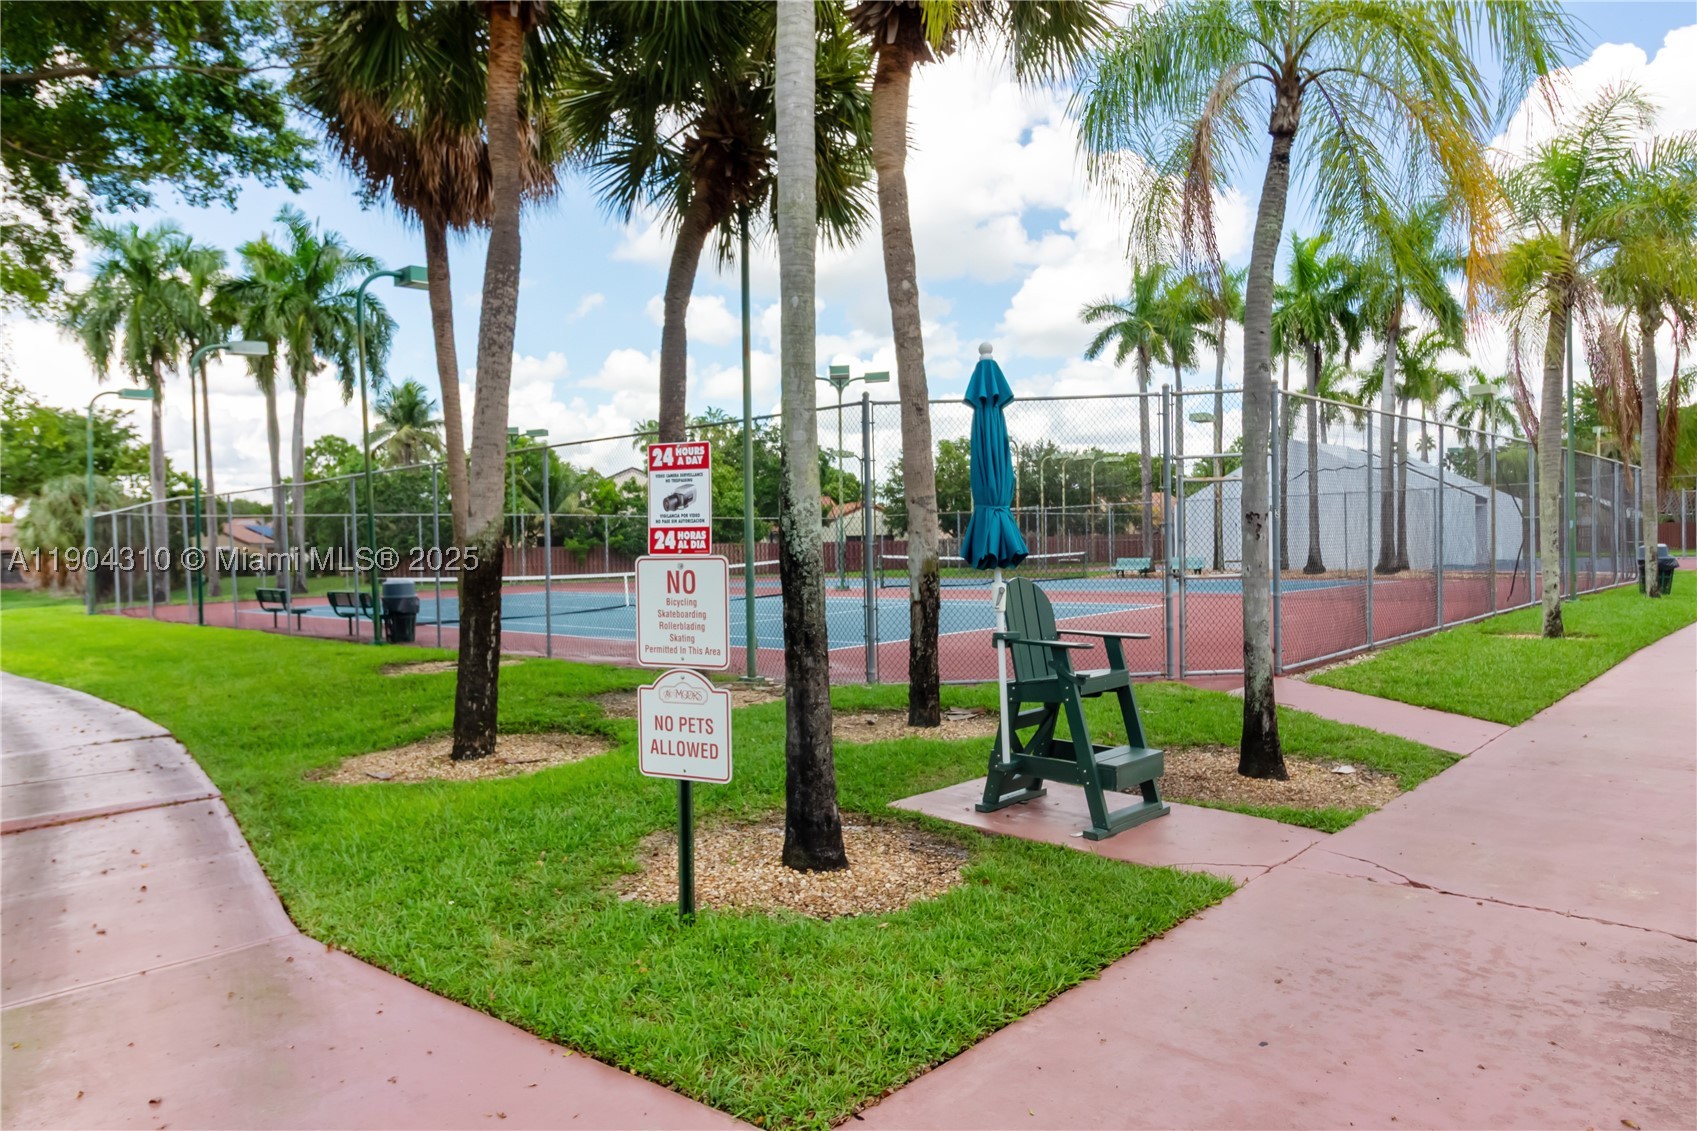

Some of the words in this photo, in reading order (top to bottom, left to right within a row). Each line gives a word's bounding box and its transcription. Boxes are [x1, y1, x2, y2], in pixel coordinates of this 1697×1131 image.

[675, 446, 705, 456] HOURS
[652, 447, 674, 467] 24
[677, 456, 684, 465] A
[686, 455, 703, 465] DAY
[654, 530, 676, 549] 24
[677, 530, 706, 540] HORAS
[677, 540, 688, 549] AL
[690, 540, 706, 549] DIA
[666, 569, 696, 594] NO
[666, 598, 697, 608] Bicycling
[657, 609, 707, 620] Skateboarding
[658, 621, 706, 632] Rollerblading
[669, 633, 695, 644] Skating
[644, 644, 678, 654] Permitted
[680, 646, 686, 654] In
[689, 646, 703, 655] This
[704, 647, 721, 656] Area
[654, 715, 673, 732] NO
[679, 716, 714, 735] PETS
[650, 738, 719, 760] ALLOWED
